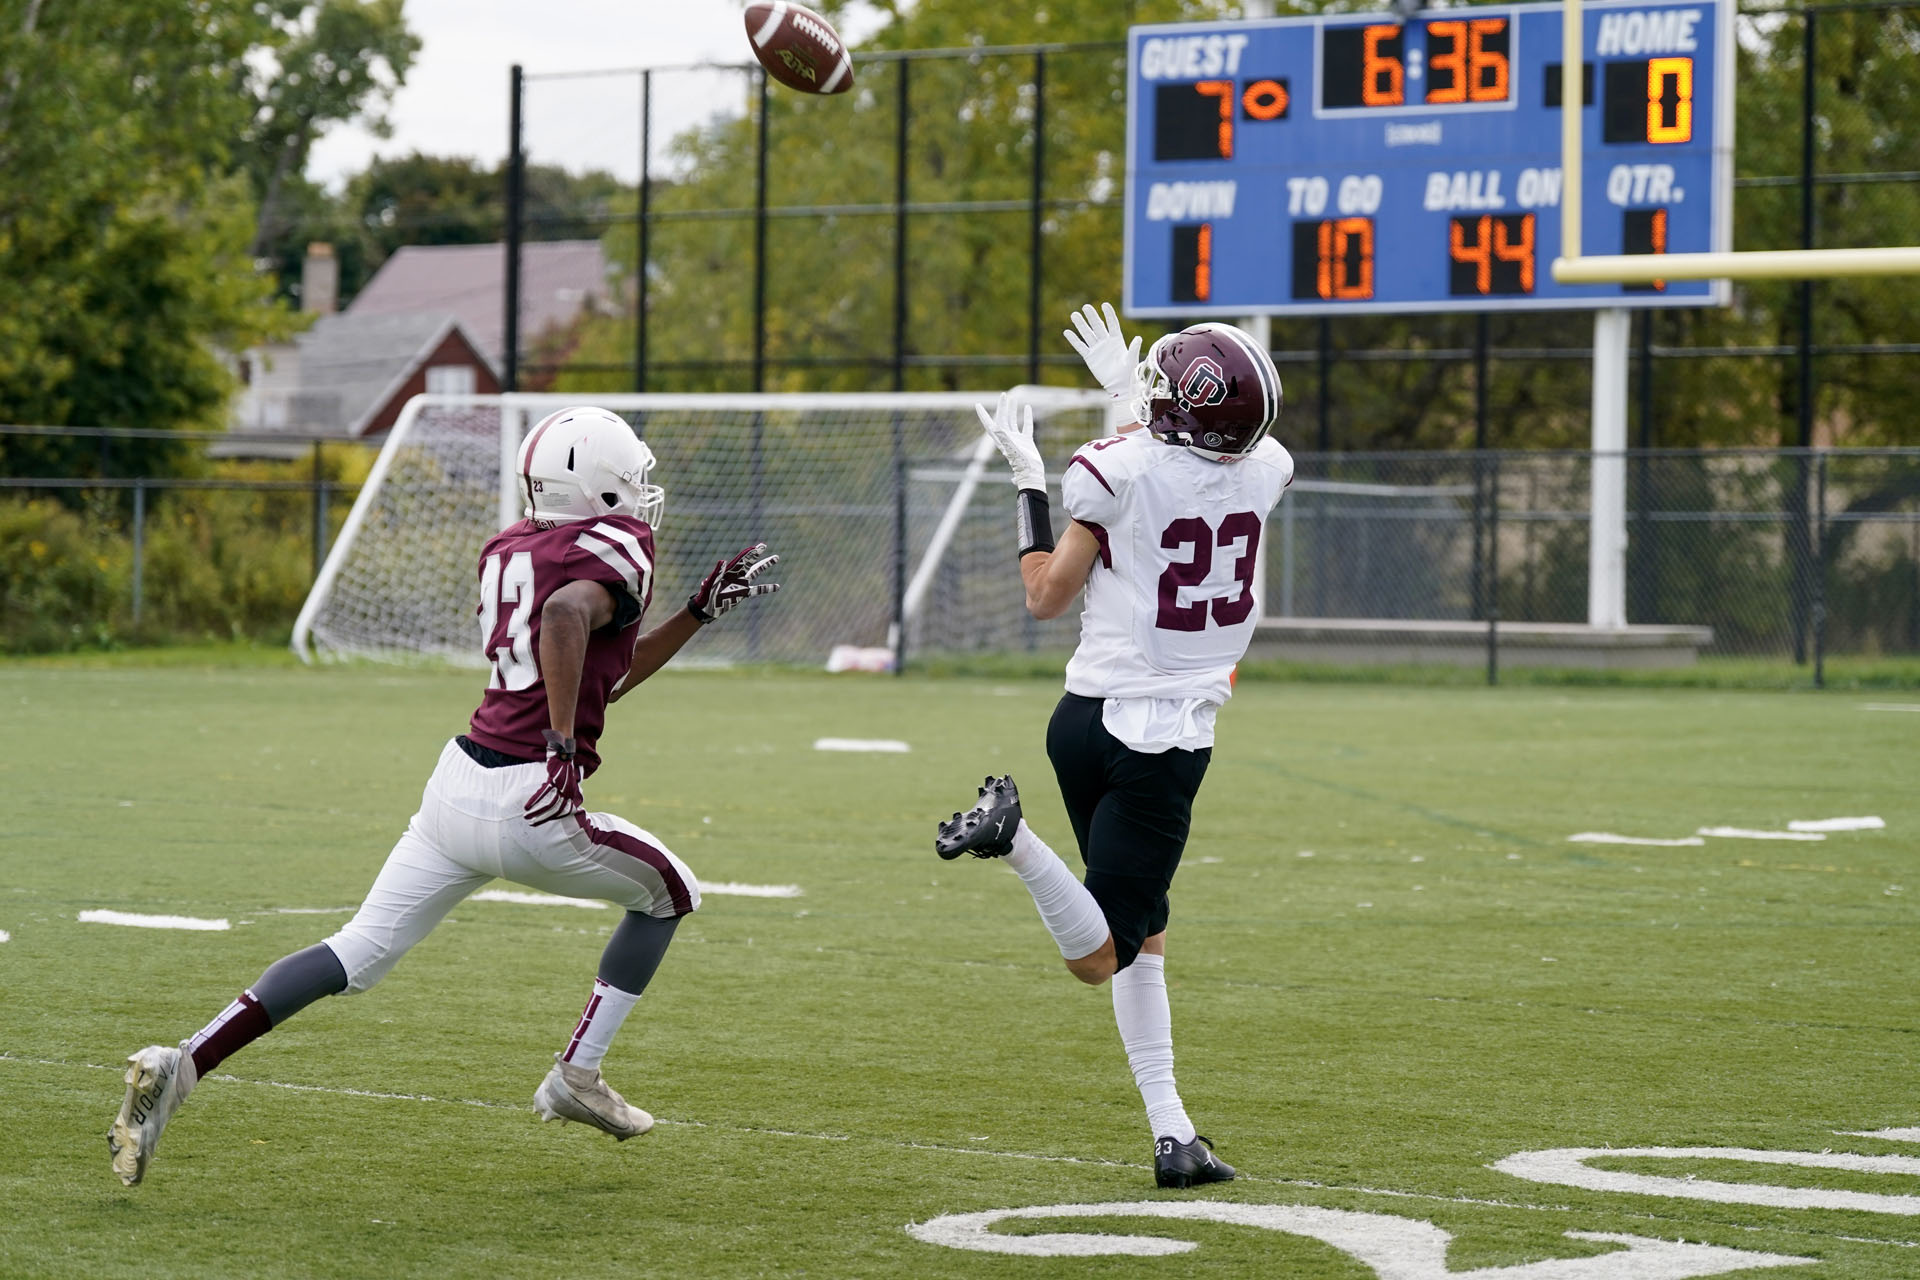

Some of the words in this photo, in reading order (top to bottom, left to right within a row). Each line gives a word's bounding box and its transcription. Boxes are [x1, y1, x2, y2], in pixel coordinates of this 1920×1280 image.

[1596, 10, 1702, 55] HOME
[1140, 35, 1248, 79] GUEST
[1362, 18, 1510, 106] 6:36
[1195, 80, 1234, 159] 7
[1647, 57, 1693, 143] 0
[1146, 181, 1237, 220] DOWN
[1287, 177, 1329, 216] TO
[1337, 175, 1383, 215] GO
[1424, 170, 1505, 210] BALL
[1516, 168, 1563, 208] ON
[1607, 164, 1684, 206] QTR.
[1195, 223, 1212, 302] 1
[1317, 217, 1374, 299] 10
[1450, 213, 1536, 293] 44
[533, 480, 544, 493] 23
[1155, 511, 1261, 632] 23
[1155, 1141, 1173, 1157] 23
